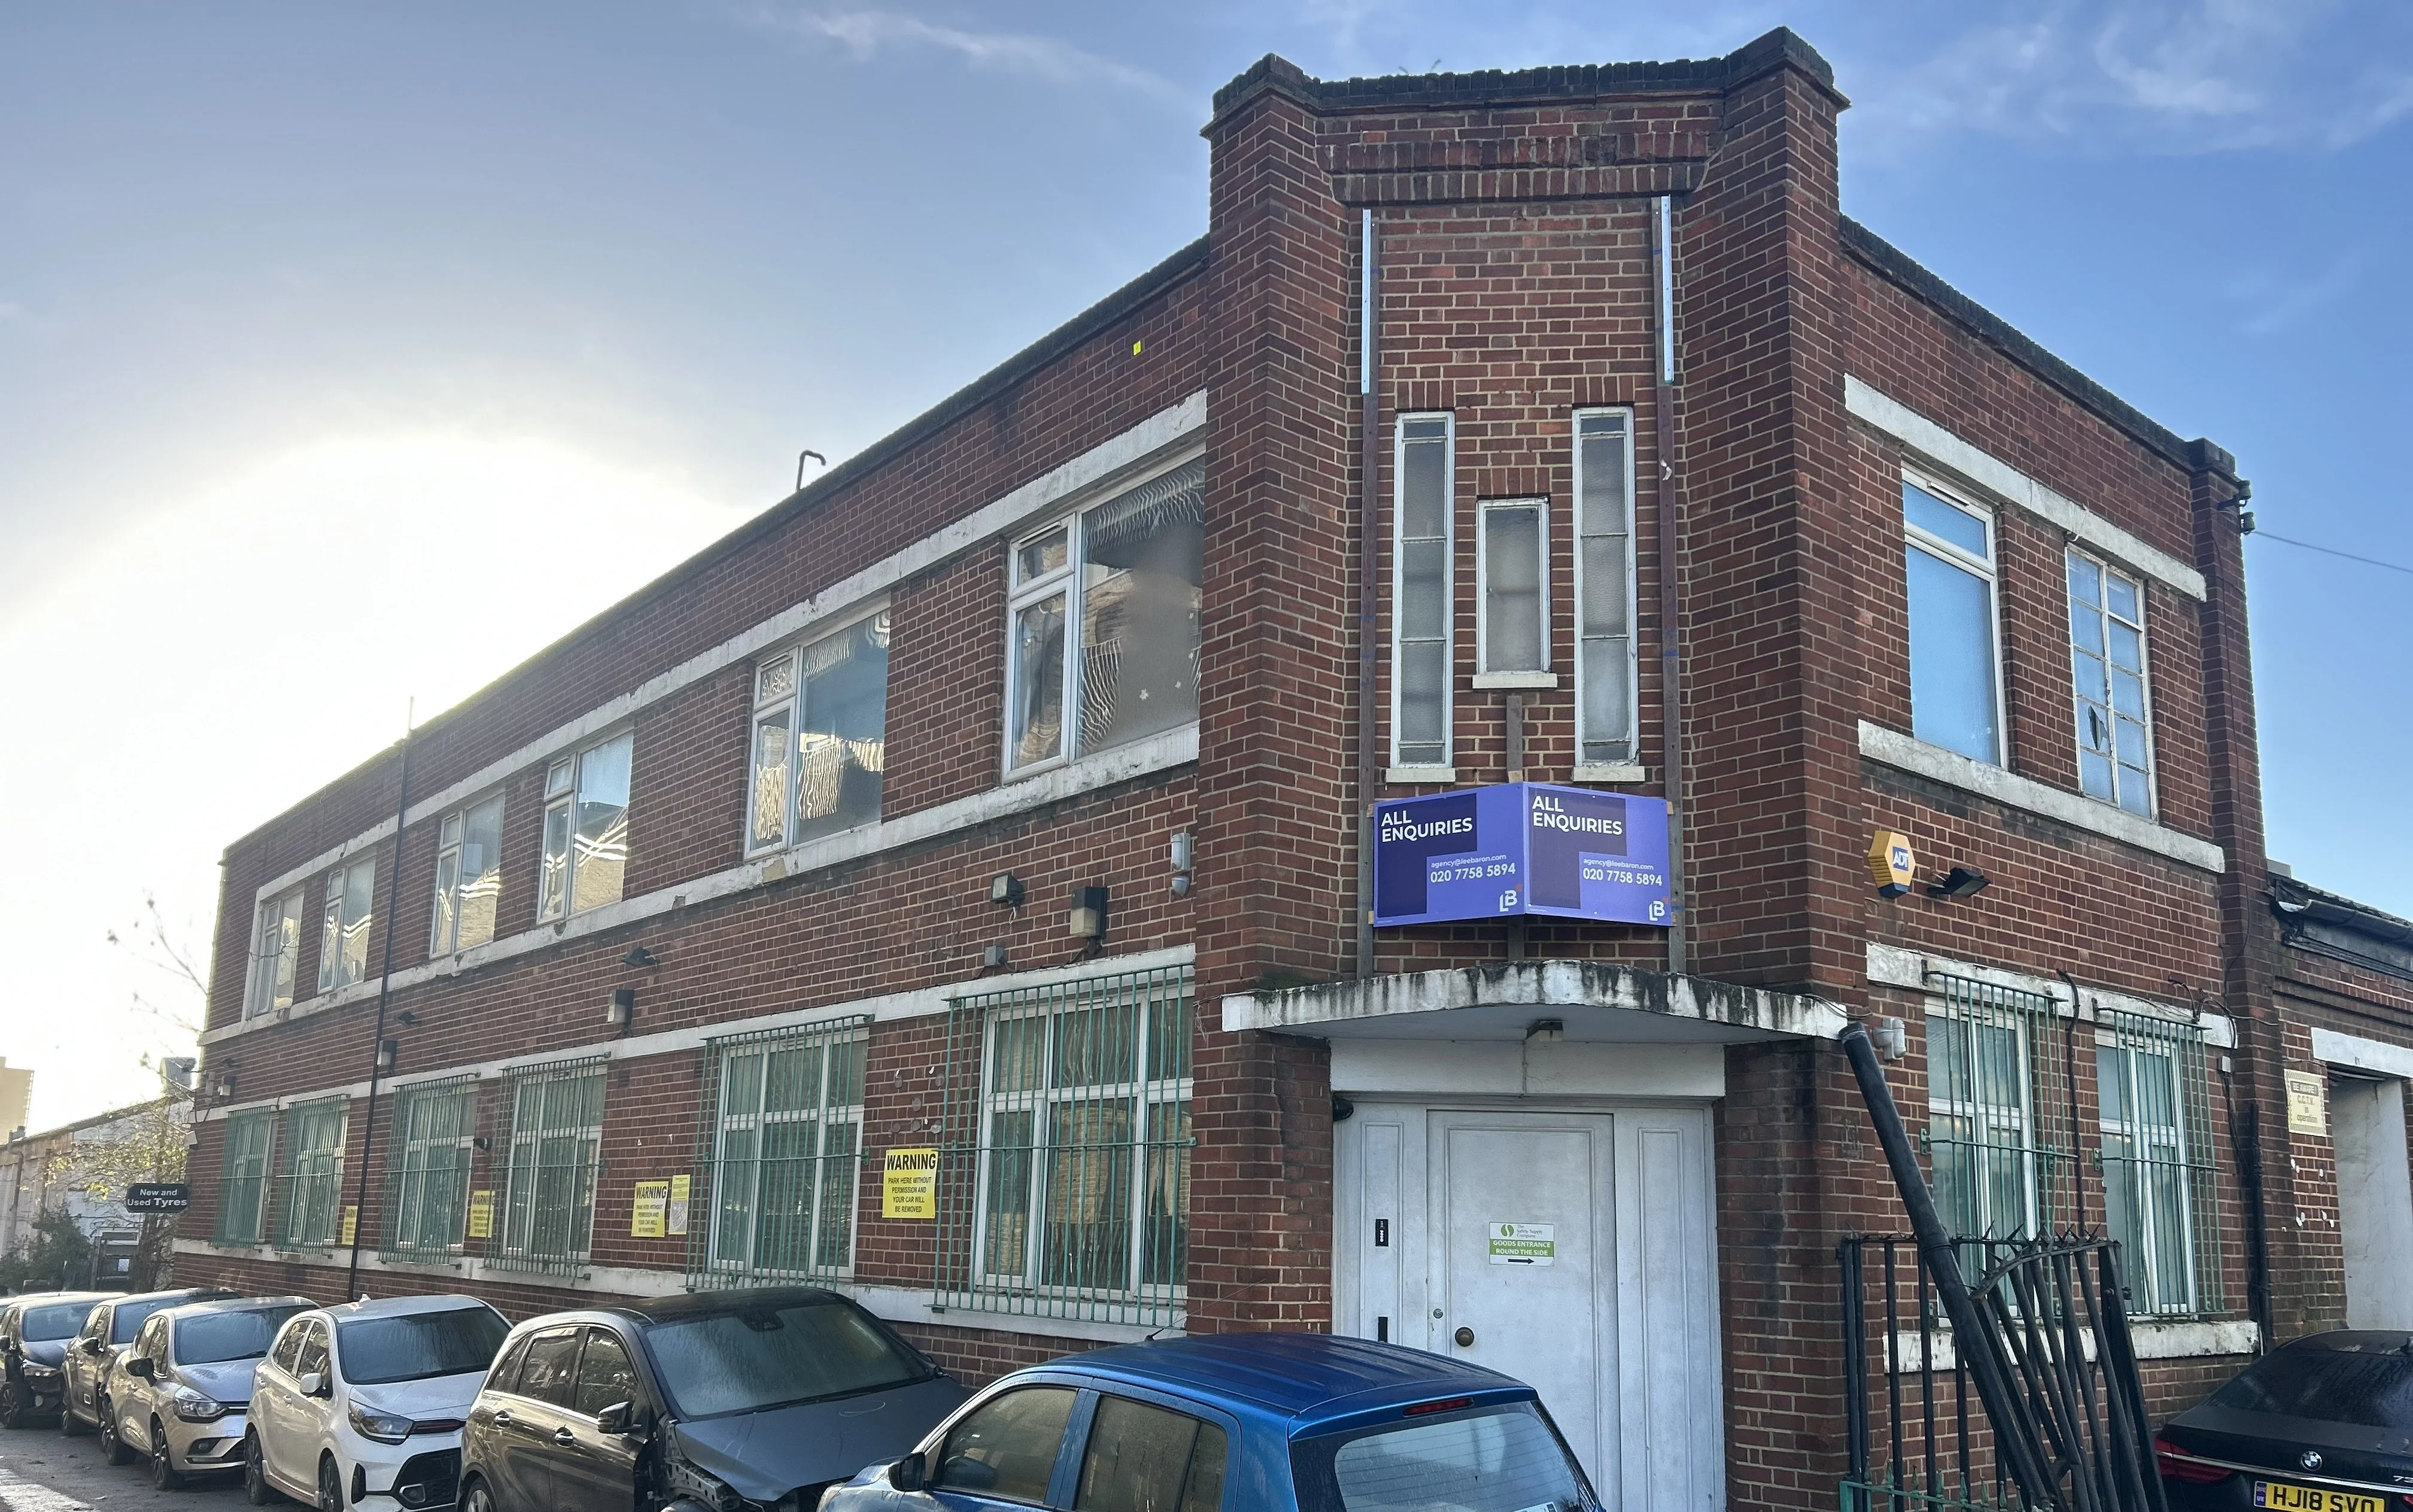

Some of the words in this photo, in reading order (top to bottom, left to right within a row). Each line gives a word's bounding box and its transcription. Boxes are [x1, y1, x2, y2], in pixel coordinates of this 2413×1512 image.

[1532, 796, 1564, 812] ALL
[1381, 810, 1412, 826] ALL
[1533, 812, 1622, 835] ENQUIRIES
[1382, 817, 1473, 842] ENQUIRIES
[1431, 854, 1506, 868] agency@leebaron.com
[1583, 859, 1654, 870] agency@leebaron.com
[1894, 851, 1908, 867] ADT
[1430, 870, 1451, 883] 020
[1455, 866, 1482, 880] 7758
[1486, 863, 1516, 877] 5894
[1583, 868, 1603, 881] 020
[1606, 870, 1633, 883] 7758
[1636, 875, 1662, 886] 5894
[887, 1154, 936, 1170] WARNING
[636, 1186, 667, 1199] WARNING
[153, 1198, 187, 1207] Tyres
[2273, 1486, 2322, 1511] HJ18
